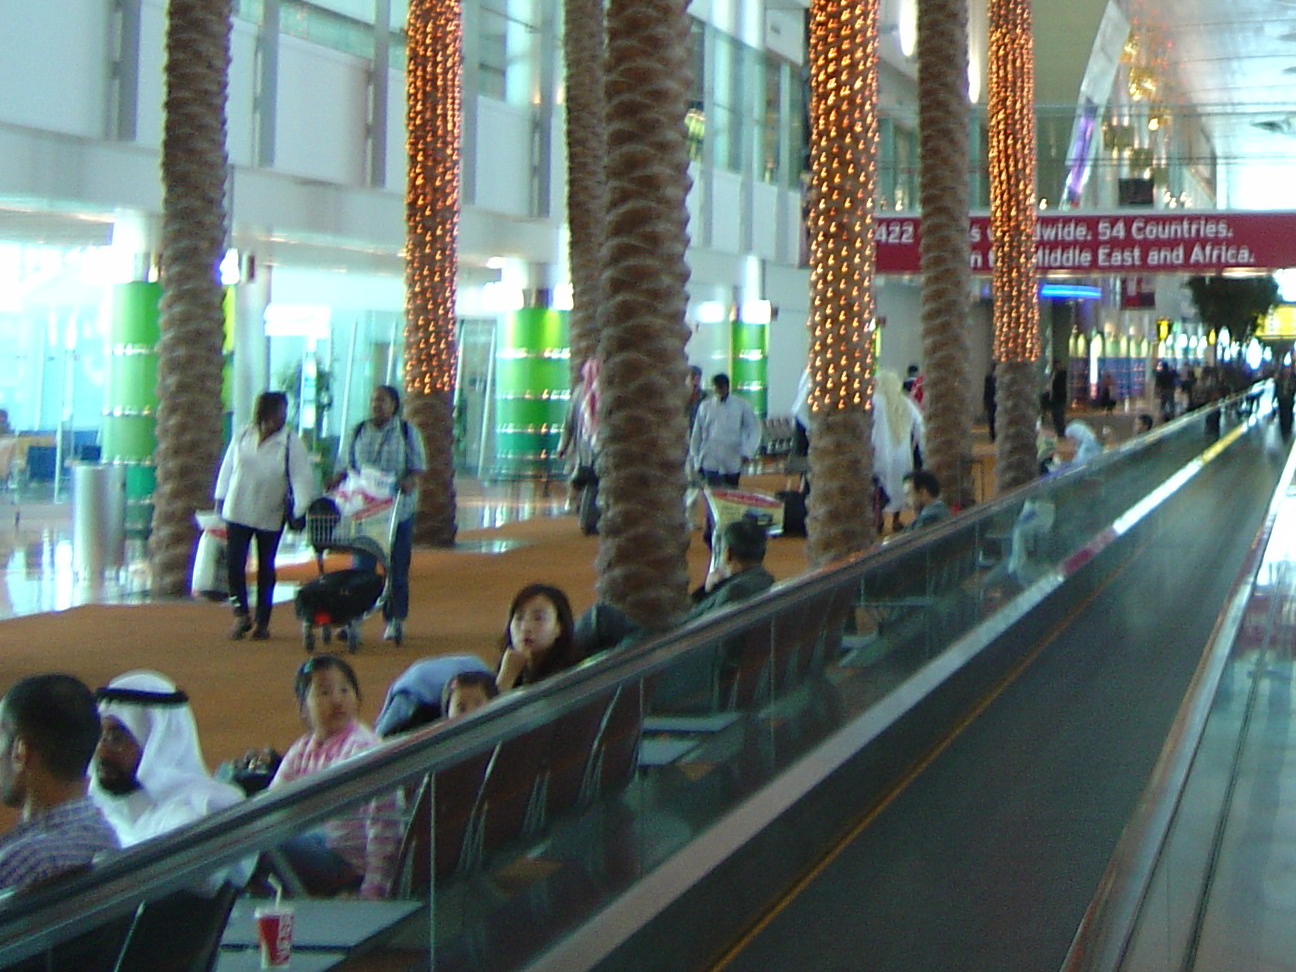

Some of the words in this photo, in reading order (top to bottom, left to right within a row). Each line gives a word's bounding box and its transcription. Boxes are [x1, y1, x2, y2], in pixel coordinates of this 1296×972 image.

[1098, 218, 1126, 241] 54
[1131, 216, 1234, 240] Countries.
[1098, 244, 1141, 266] East
[1147, 243, 1184, 265] and
[1190, 241, 1255, 265] Africa.
